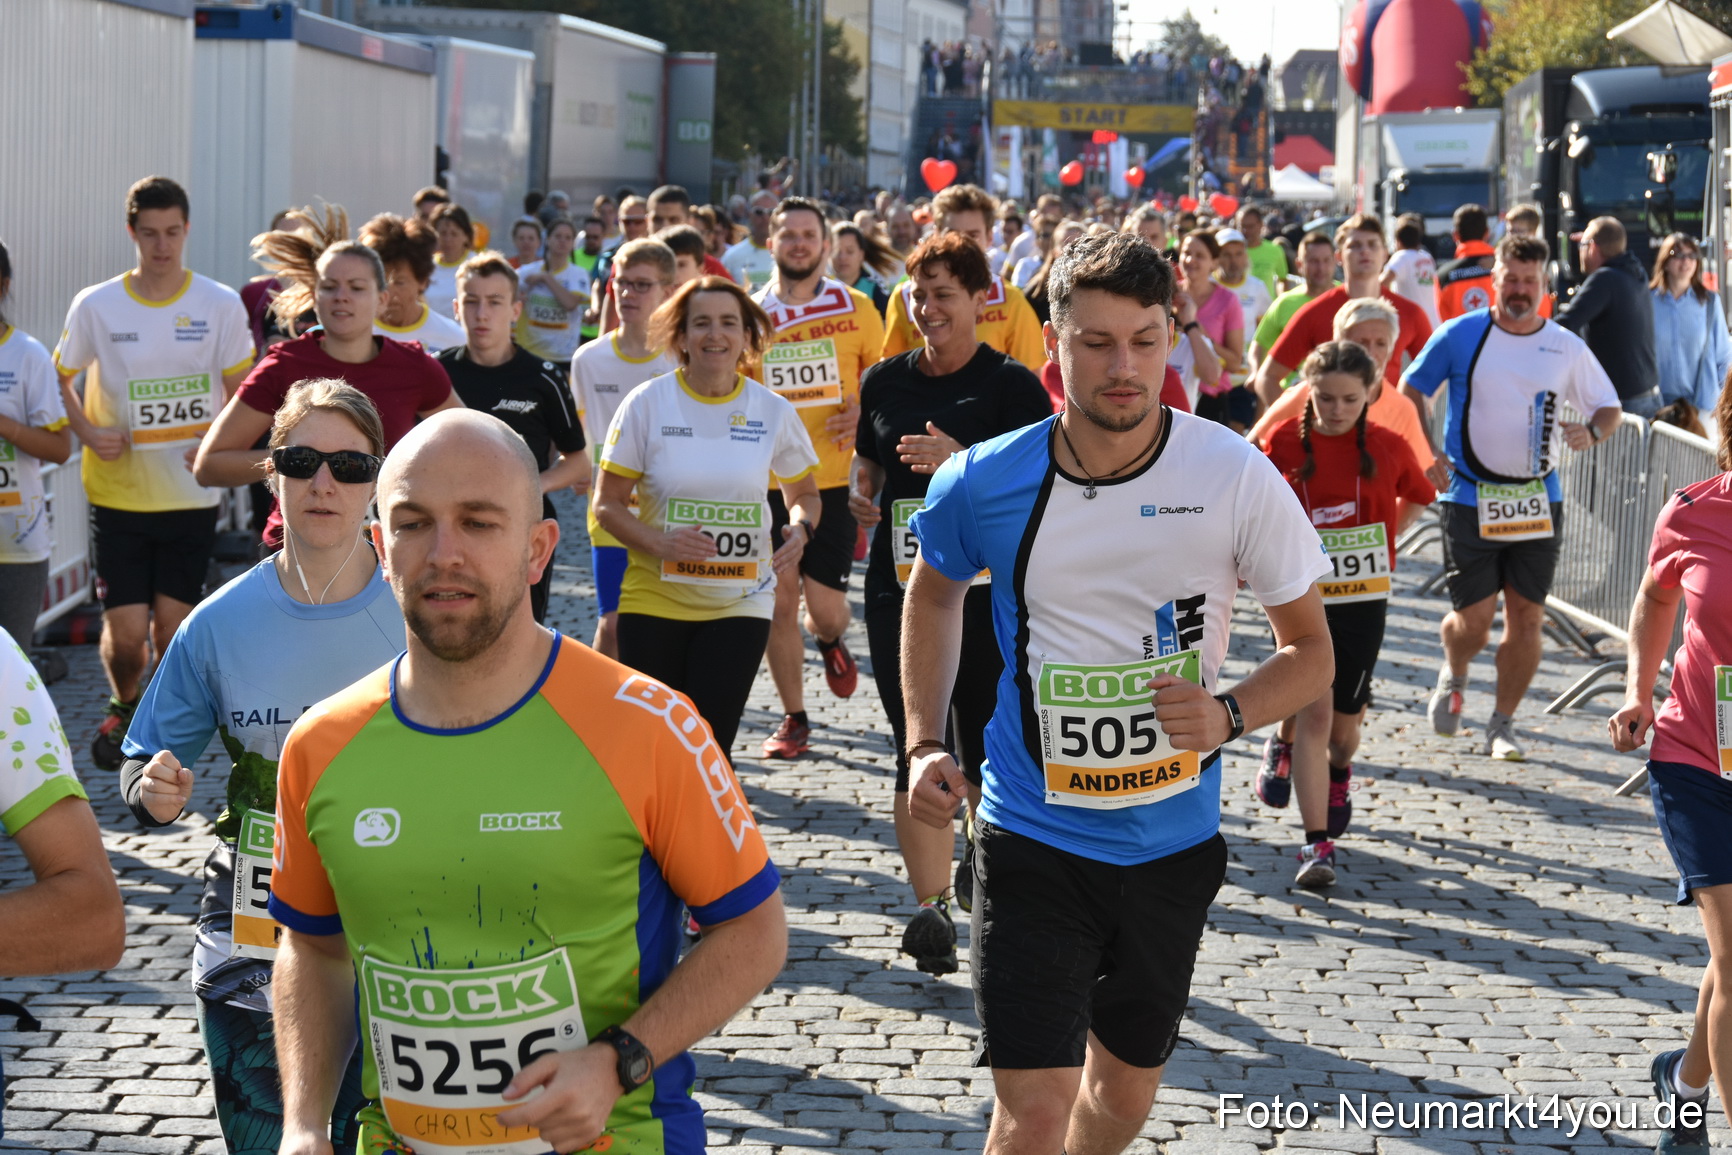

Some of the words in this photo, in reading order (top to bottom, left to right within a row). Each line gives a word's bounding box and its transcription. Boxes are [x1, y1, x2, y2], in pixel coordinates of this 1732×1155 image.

[1060, 108, 1129, 124] START
[809, 320, 860, 339] BÖGL
[769, 342, 830, 361] BOCK
[772, 363, 828, 386] 5101
[134, 376, 206, 398] BOCK
[140, 398, 204, 425] 5246
[730, 415, 747, 426] 20
[674, 501, 756, 524] BOCK
[1488, 498, 1541, 520] 5049
[701, 531, 751, 557] 09
[1321, 528, 1380, 547] OCK
[677, 562, 745, 576] SUSANNE
[1331, 552, 1376, 577] 191
[1323, 583, 1368, 595] KATJA
[1060, 711, 1157, 759] 505
[613, 674, 755, 853] BOCK
[1069, 761, 1181, 792] ANDREAS
[480, 811, 563, 832] BOCK
[373, 965, 559, 1021] BOCK
